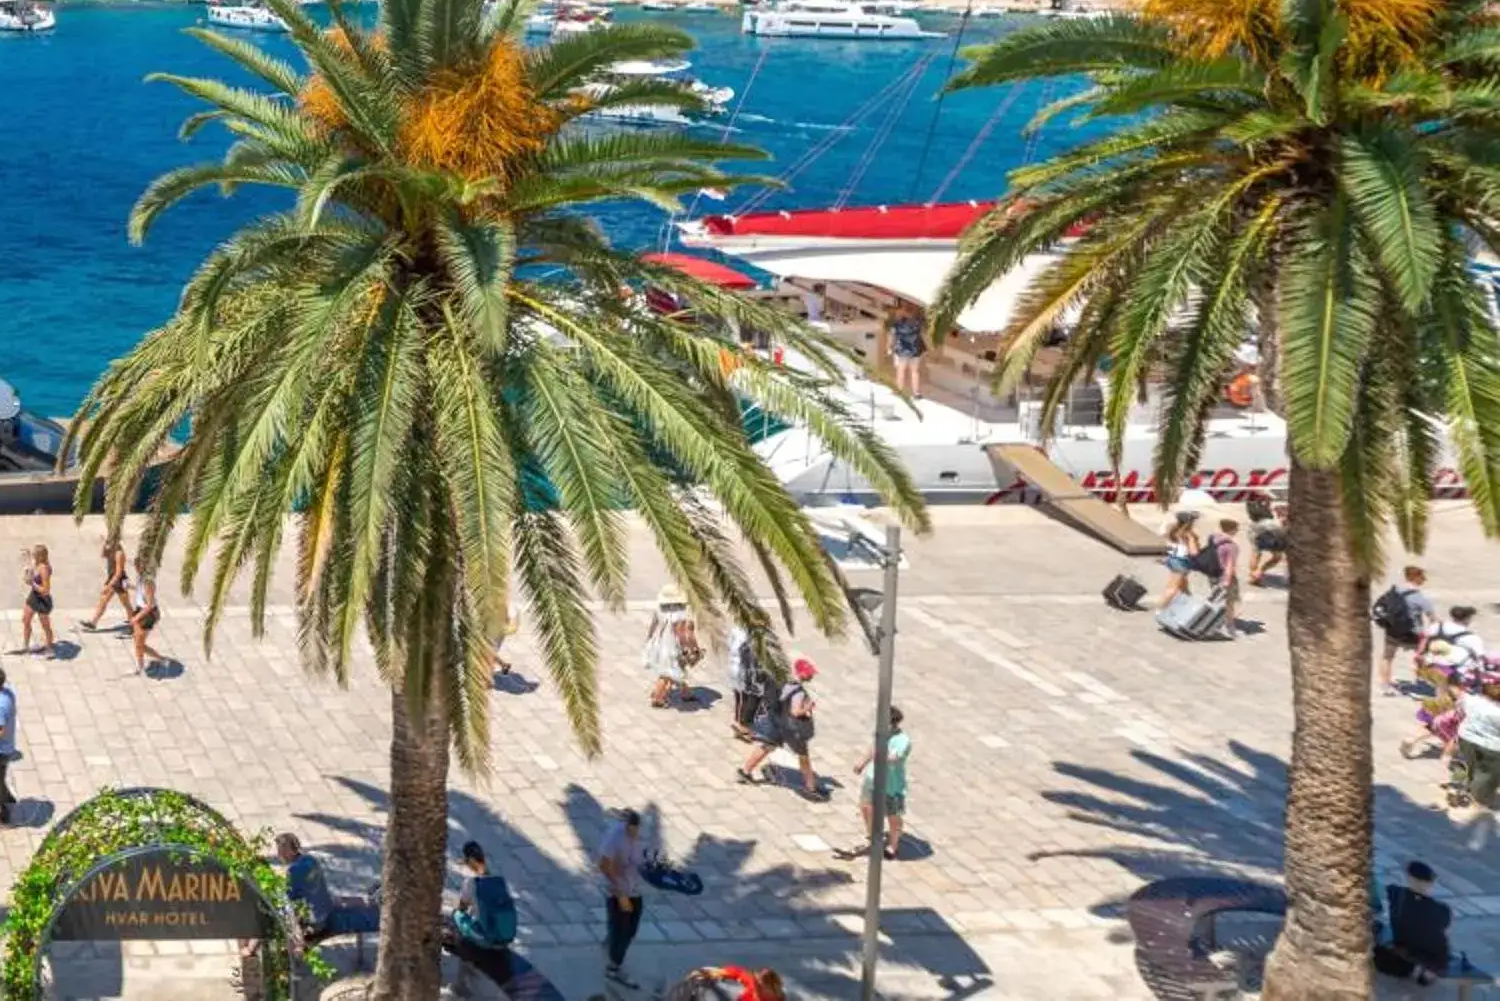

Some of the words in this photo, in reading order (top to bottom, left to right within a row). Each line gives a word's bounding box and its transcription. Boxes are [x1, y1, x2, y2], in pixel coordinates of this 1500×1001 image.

[136, 864, 241, 902] MARINA
[105, 911, 148, 925] HVAR
[154, 911, 208, 925] HOTEL
